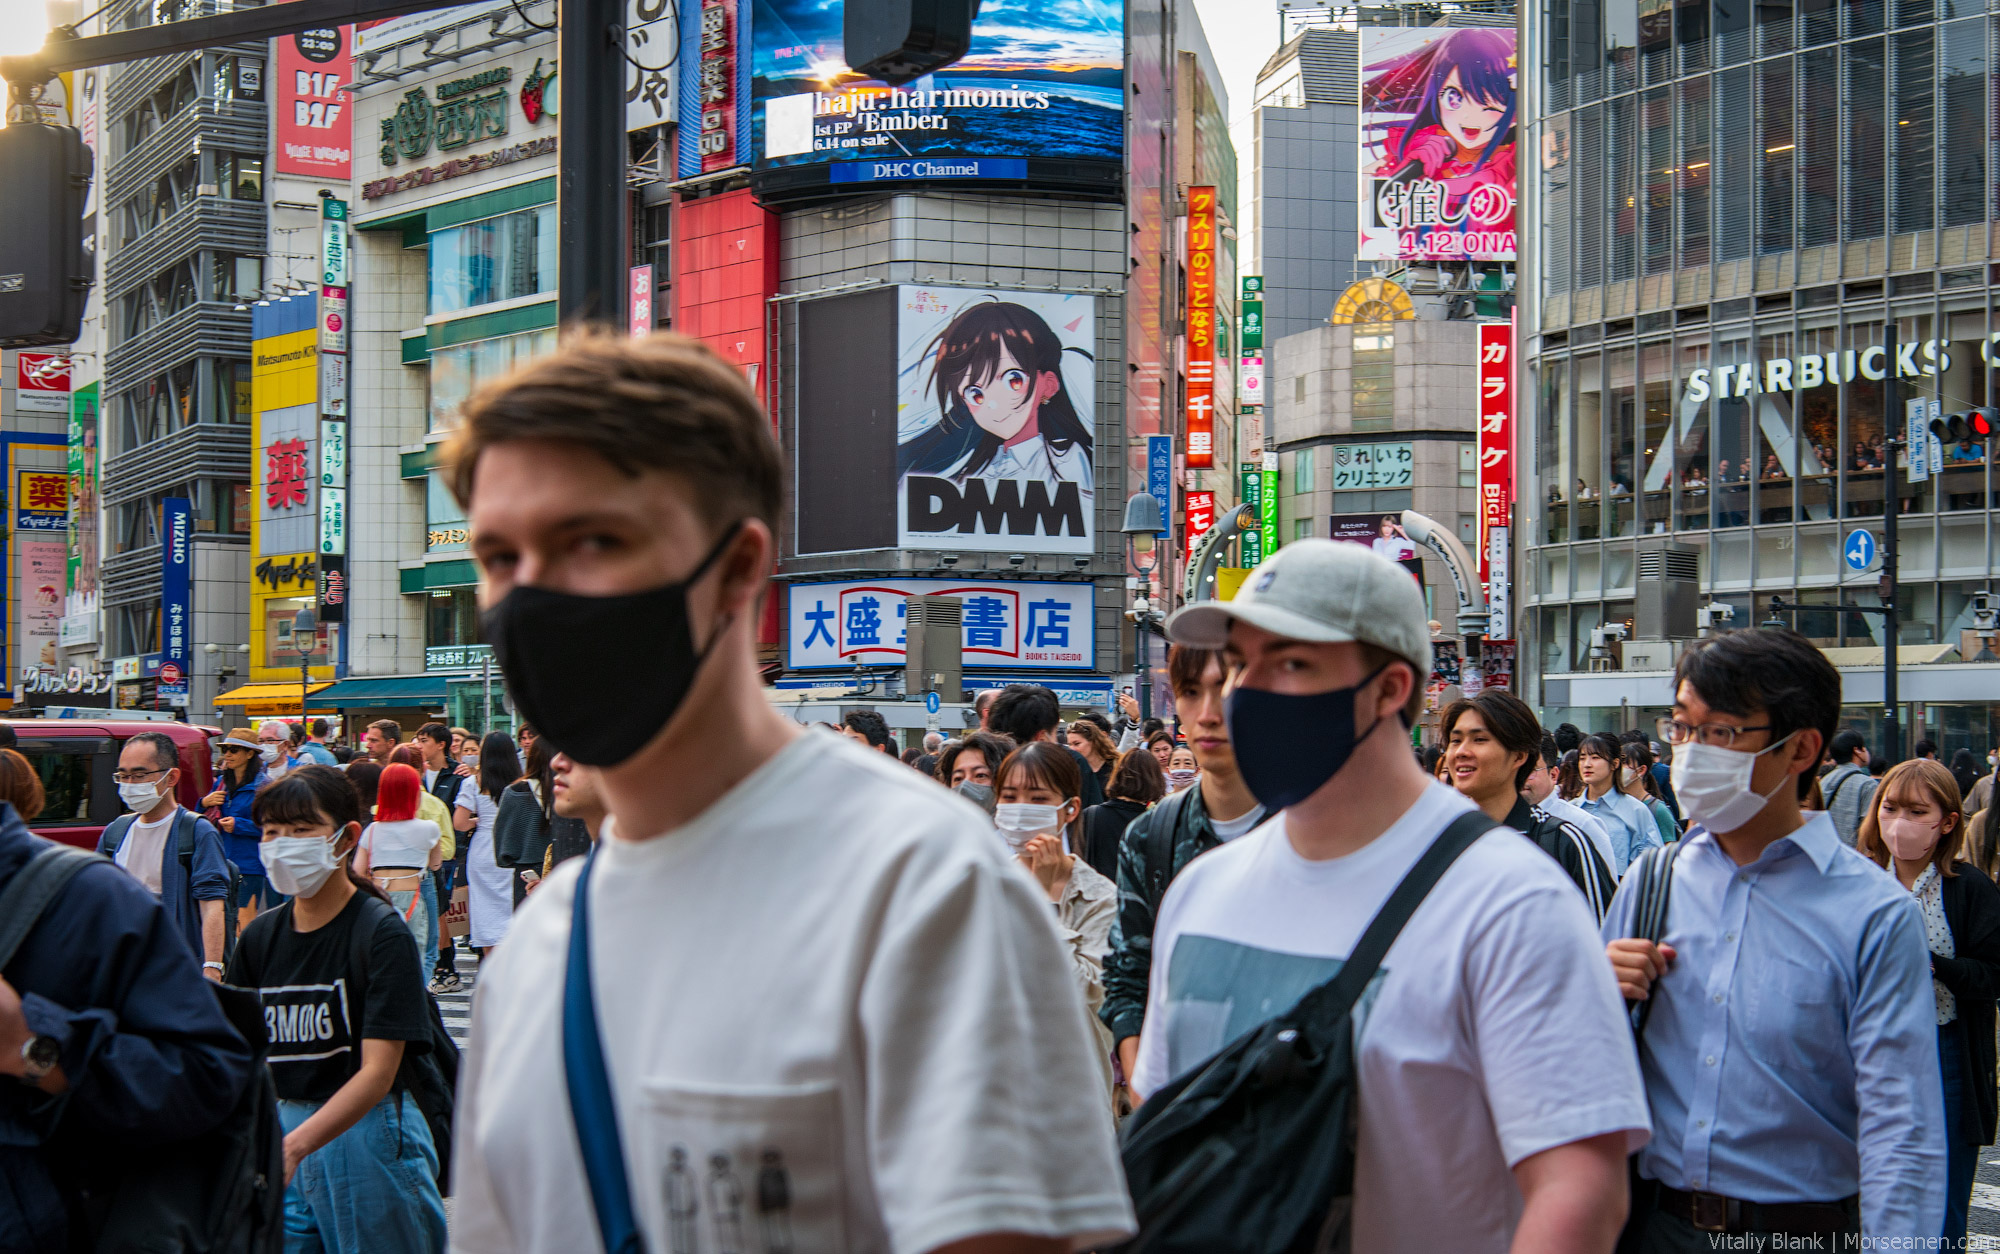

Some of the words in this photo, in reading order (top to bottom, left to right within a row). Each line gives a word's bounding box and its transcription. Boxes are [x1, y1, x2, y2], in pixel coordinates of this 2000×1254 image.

[296, 70, 341, 98] B1F
[336, 90, 346, 102] &
[295, 100, 342, 129] B2F
[815, 124, 832, 136] 1st
[834, 122, 852, 135] EP
[814, 138, 838, 151] 6.14
[841, 138, 858, 149] on
[861, 134, 889, 148] sale
[873, 164, 910, 179] DHC
[913, 162, 979, 177] Channel
[1191, 194, 1211, 347] クスリのことなら
[1688, 338, 1951, 403] STARBUCKS
[1482, 342, 1508, 468] カラオケ
[1355, 448, 1412, 465] れいわ
[265, 438, 308, 509] 薬
[1336, 469, 1412, 487] クリニック
[28, 476, 67, 508] 薬
[907, 475, 1087, 538] DMM
[1483, 484, 1501, 514] BIG
[173, 512, 186, 564] MIZUHO
[25, 666, 113, 696] グルメタウン
[445, 901, 467, 916] UJI
